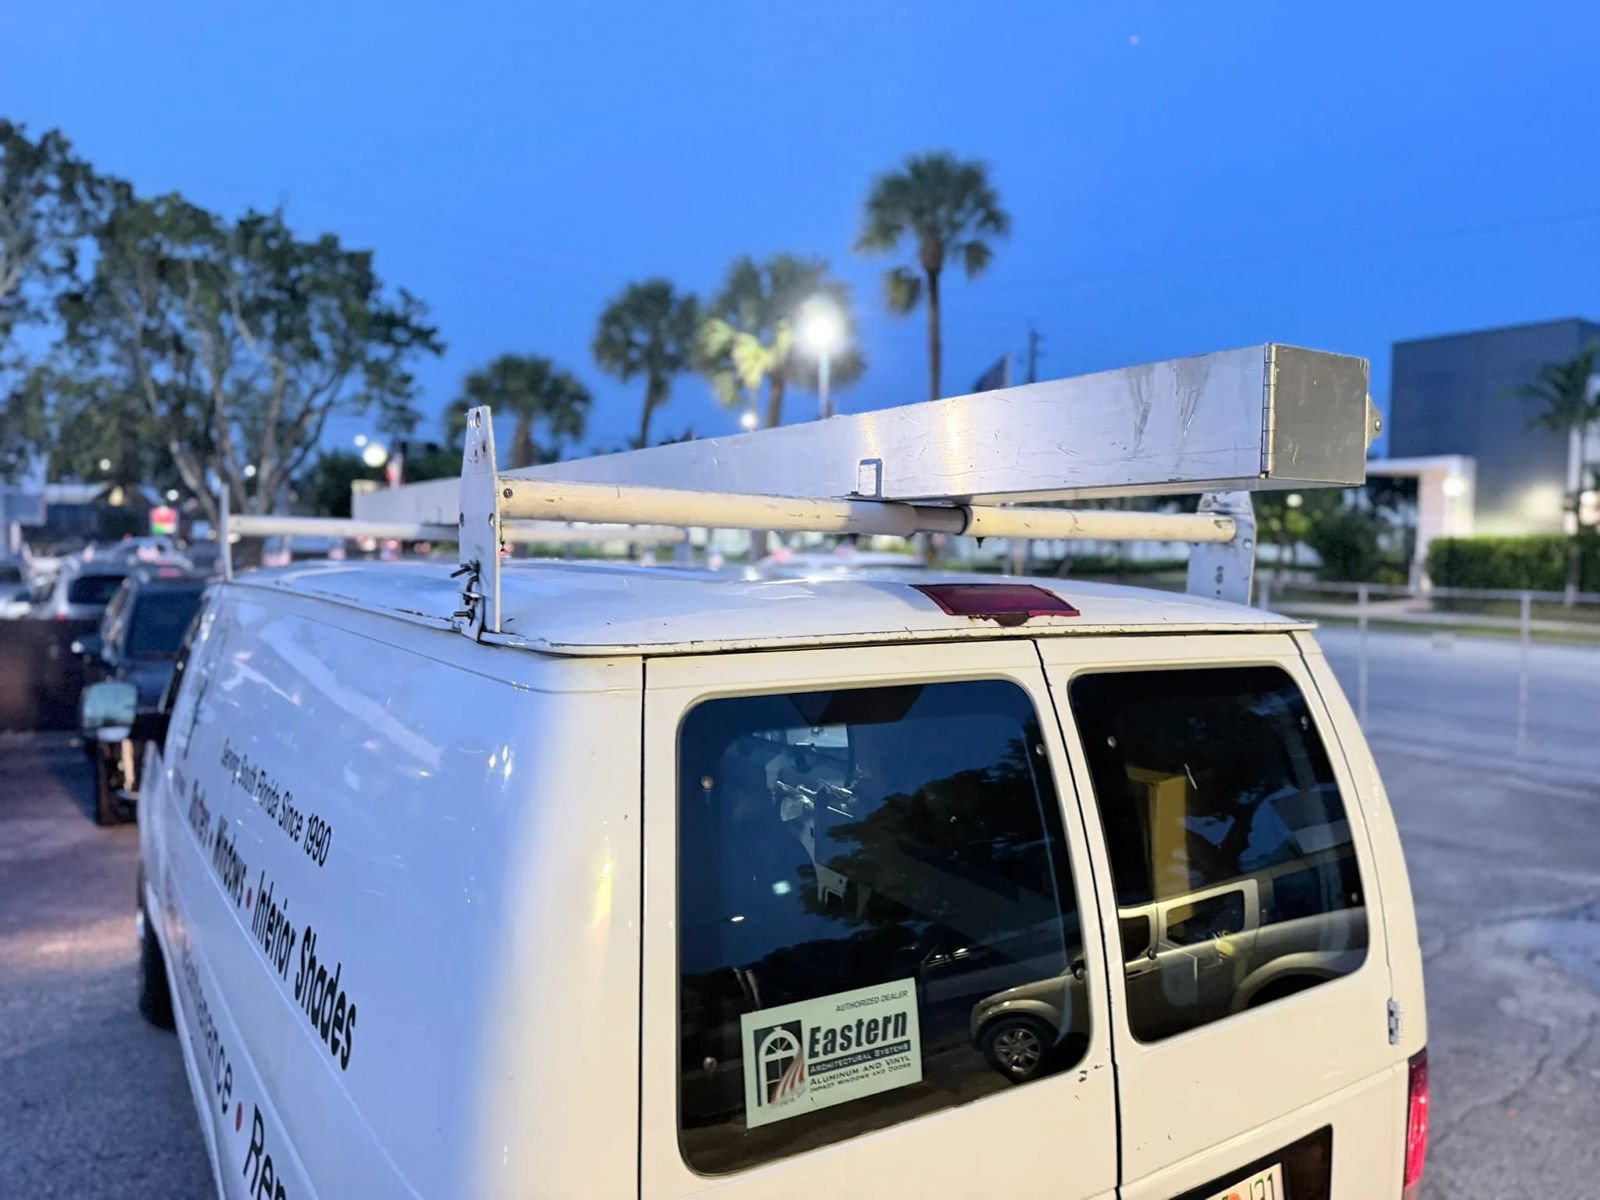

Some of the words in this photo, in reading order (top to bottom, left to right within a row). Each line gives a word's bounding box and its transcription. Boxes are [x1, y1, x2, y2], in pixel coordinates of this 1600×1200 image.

[237, 754, 258, 799] South
[254, 770, 281, 819] Florida
[277, 791, 303, 843] Since
[303, 813, 332, 868] 1990
[251, 870, 297, 982] Interior
[294, 926, 356, 1071] Shades
[836, 996, 880, 1012] AUTHORIZED
[880, 990, 908, 1004] DEALER
[808, 1011, 908, 1060] Eastern
[809, 1053, 873, 1073] ARCHITECTURAL
[874, 1043, 909, 1057] SYSTEMS
[809, 1068, 860, 1086] ALUMINUM
[863, 1062, 882, 1072] AND
[885, 1055, 911, 1067] VINYL
[872, 1069, 886, 1077] AND
